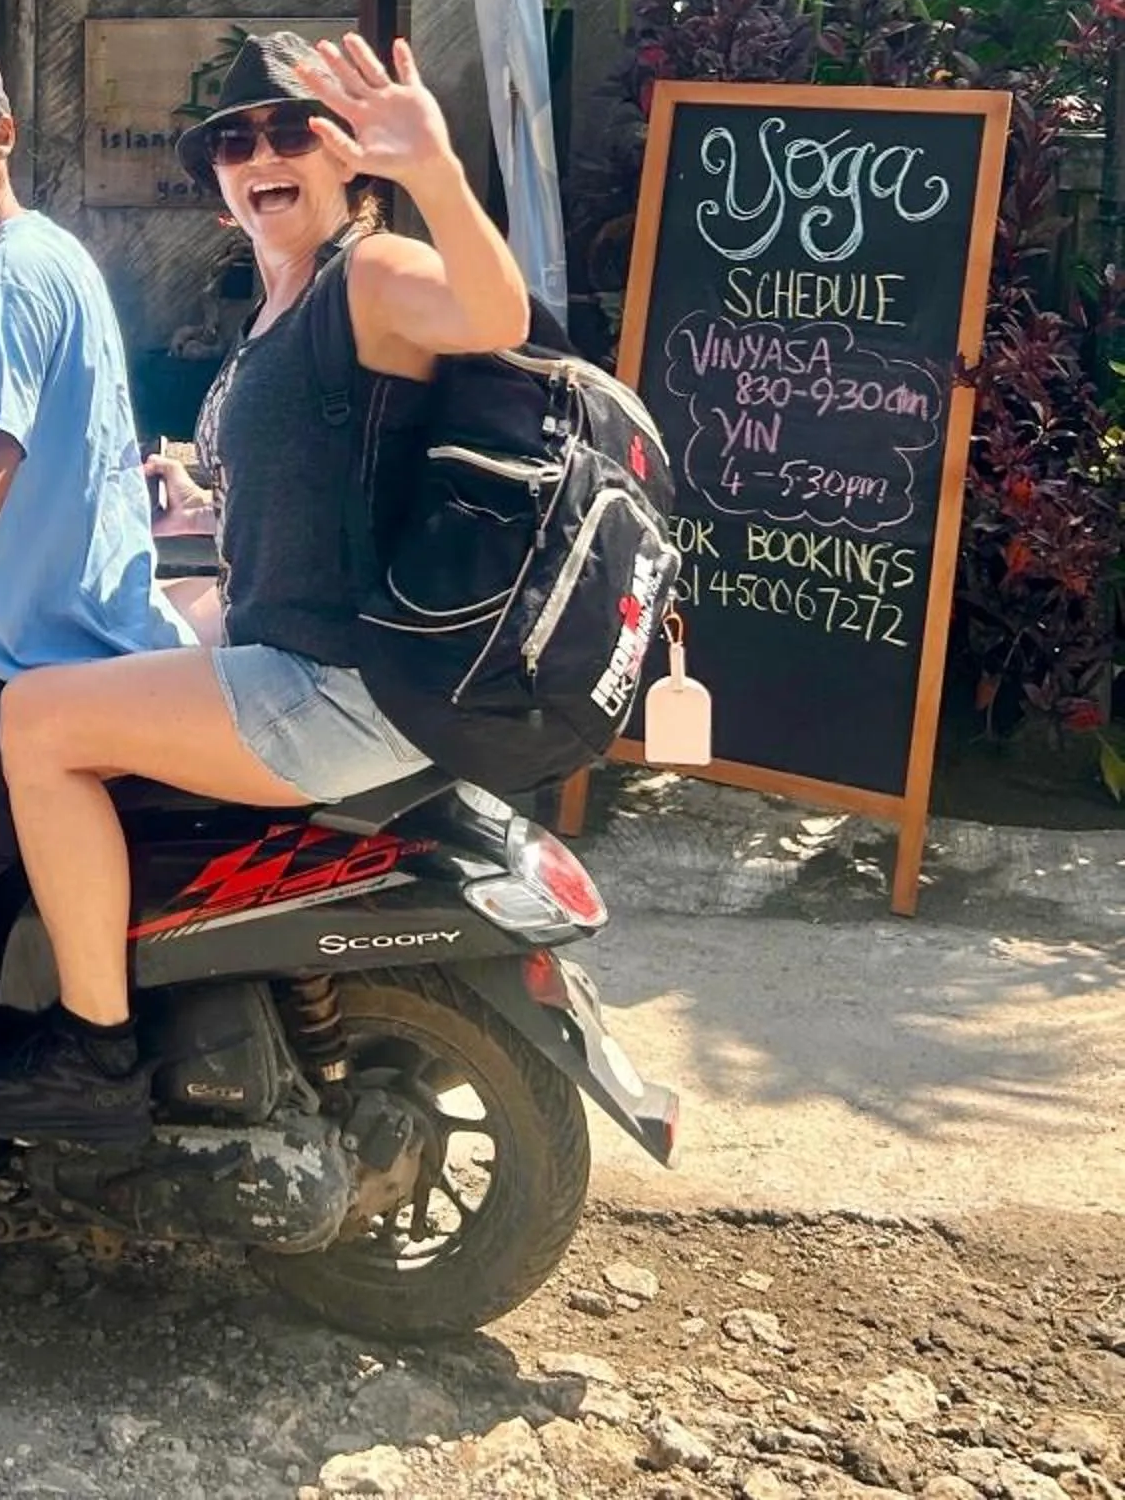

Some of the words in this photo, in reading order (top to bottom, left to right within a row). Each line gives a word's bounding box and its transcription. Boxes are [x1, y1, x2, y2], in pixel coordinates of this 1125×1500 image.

[697, 117, 949, 262] Yoga
[724, 267, 906, 327] SCHEDULE
[680, 324, 833, 376] VINYASA
[712, 408, 783, 456] YIN
[748, 522, 915, 594] BOOKINGS
